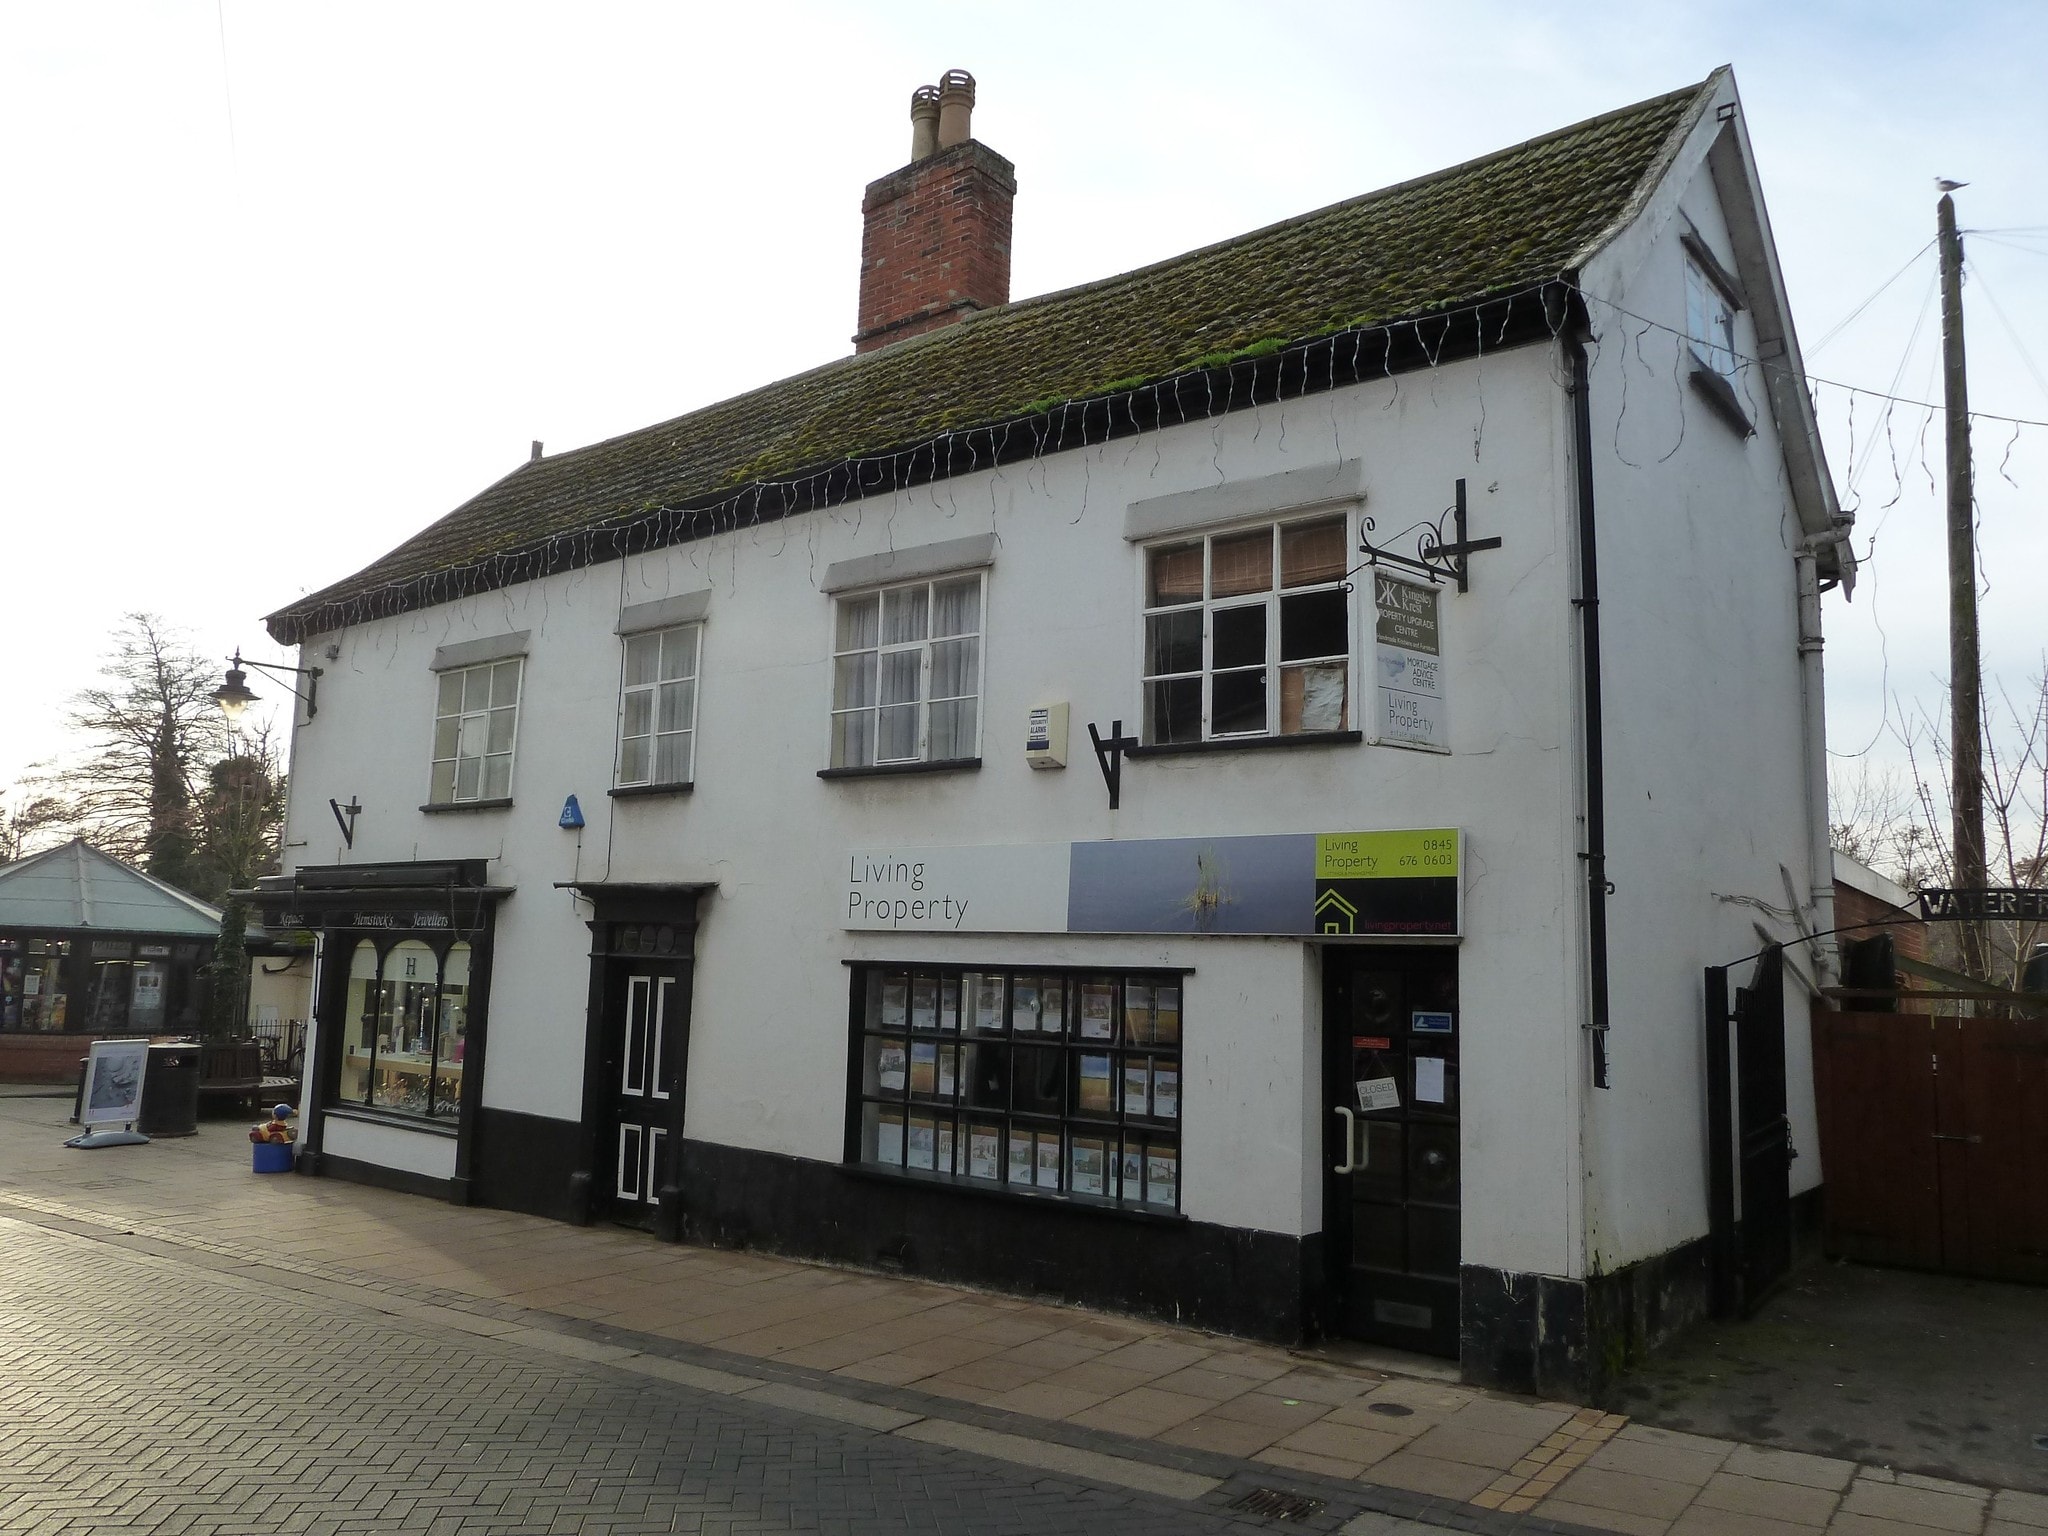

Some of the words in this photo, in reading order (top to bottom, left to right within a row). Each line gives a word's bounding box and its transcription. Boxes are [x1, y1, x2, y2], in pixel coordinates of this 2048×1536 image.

[1401, 585, 1433, 608] Kingsley
[1402, 597, 1422, 614] Krest
[1394, 624, 1419, 638] CENTRE
[1407, 616, 1435, 630] UPGRADE
[1407, 657, 1439, 672] MORTGAGE
[1412, 668, 1434, 681] ADVICE
[1412, 677, 1436, 690] CENTRE
[1388, 692, 1418, 716] Living
[1030, 726, 1047, 734] ALARMS
[1389, 709, 1434, 735] Property
[1325, 838, 1358, 854] Living
[1423, 839, 1452, 851] 0845
[1324, 854, 1378, 873] Property
[1399, 855, 1418, 866] 676
[1423, 854, 1452, 866] 0603
[850, 854, 925, 891] Living
[848, 891, 969, 929] Property
[352, 912, 394, 928] Hemstock's
[411, 912, 449, 928] Jewellers
[405, 957, 417, 975] H
[1360, 1083, 1394, 1095] CLOSED
